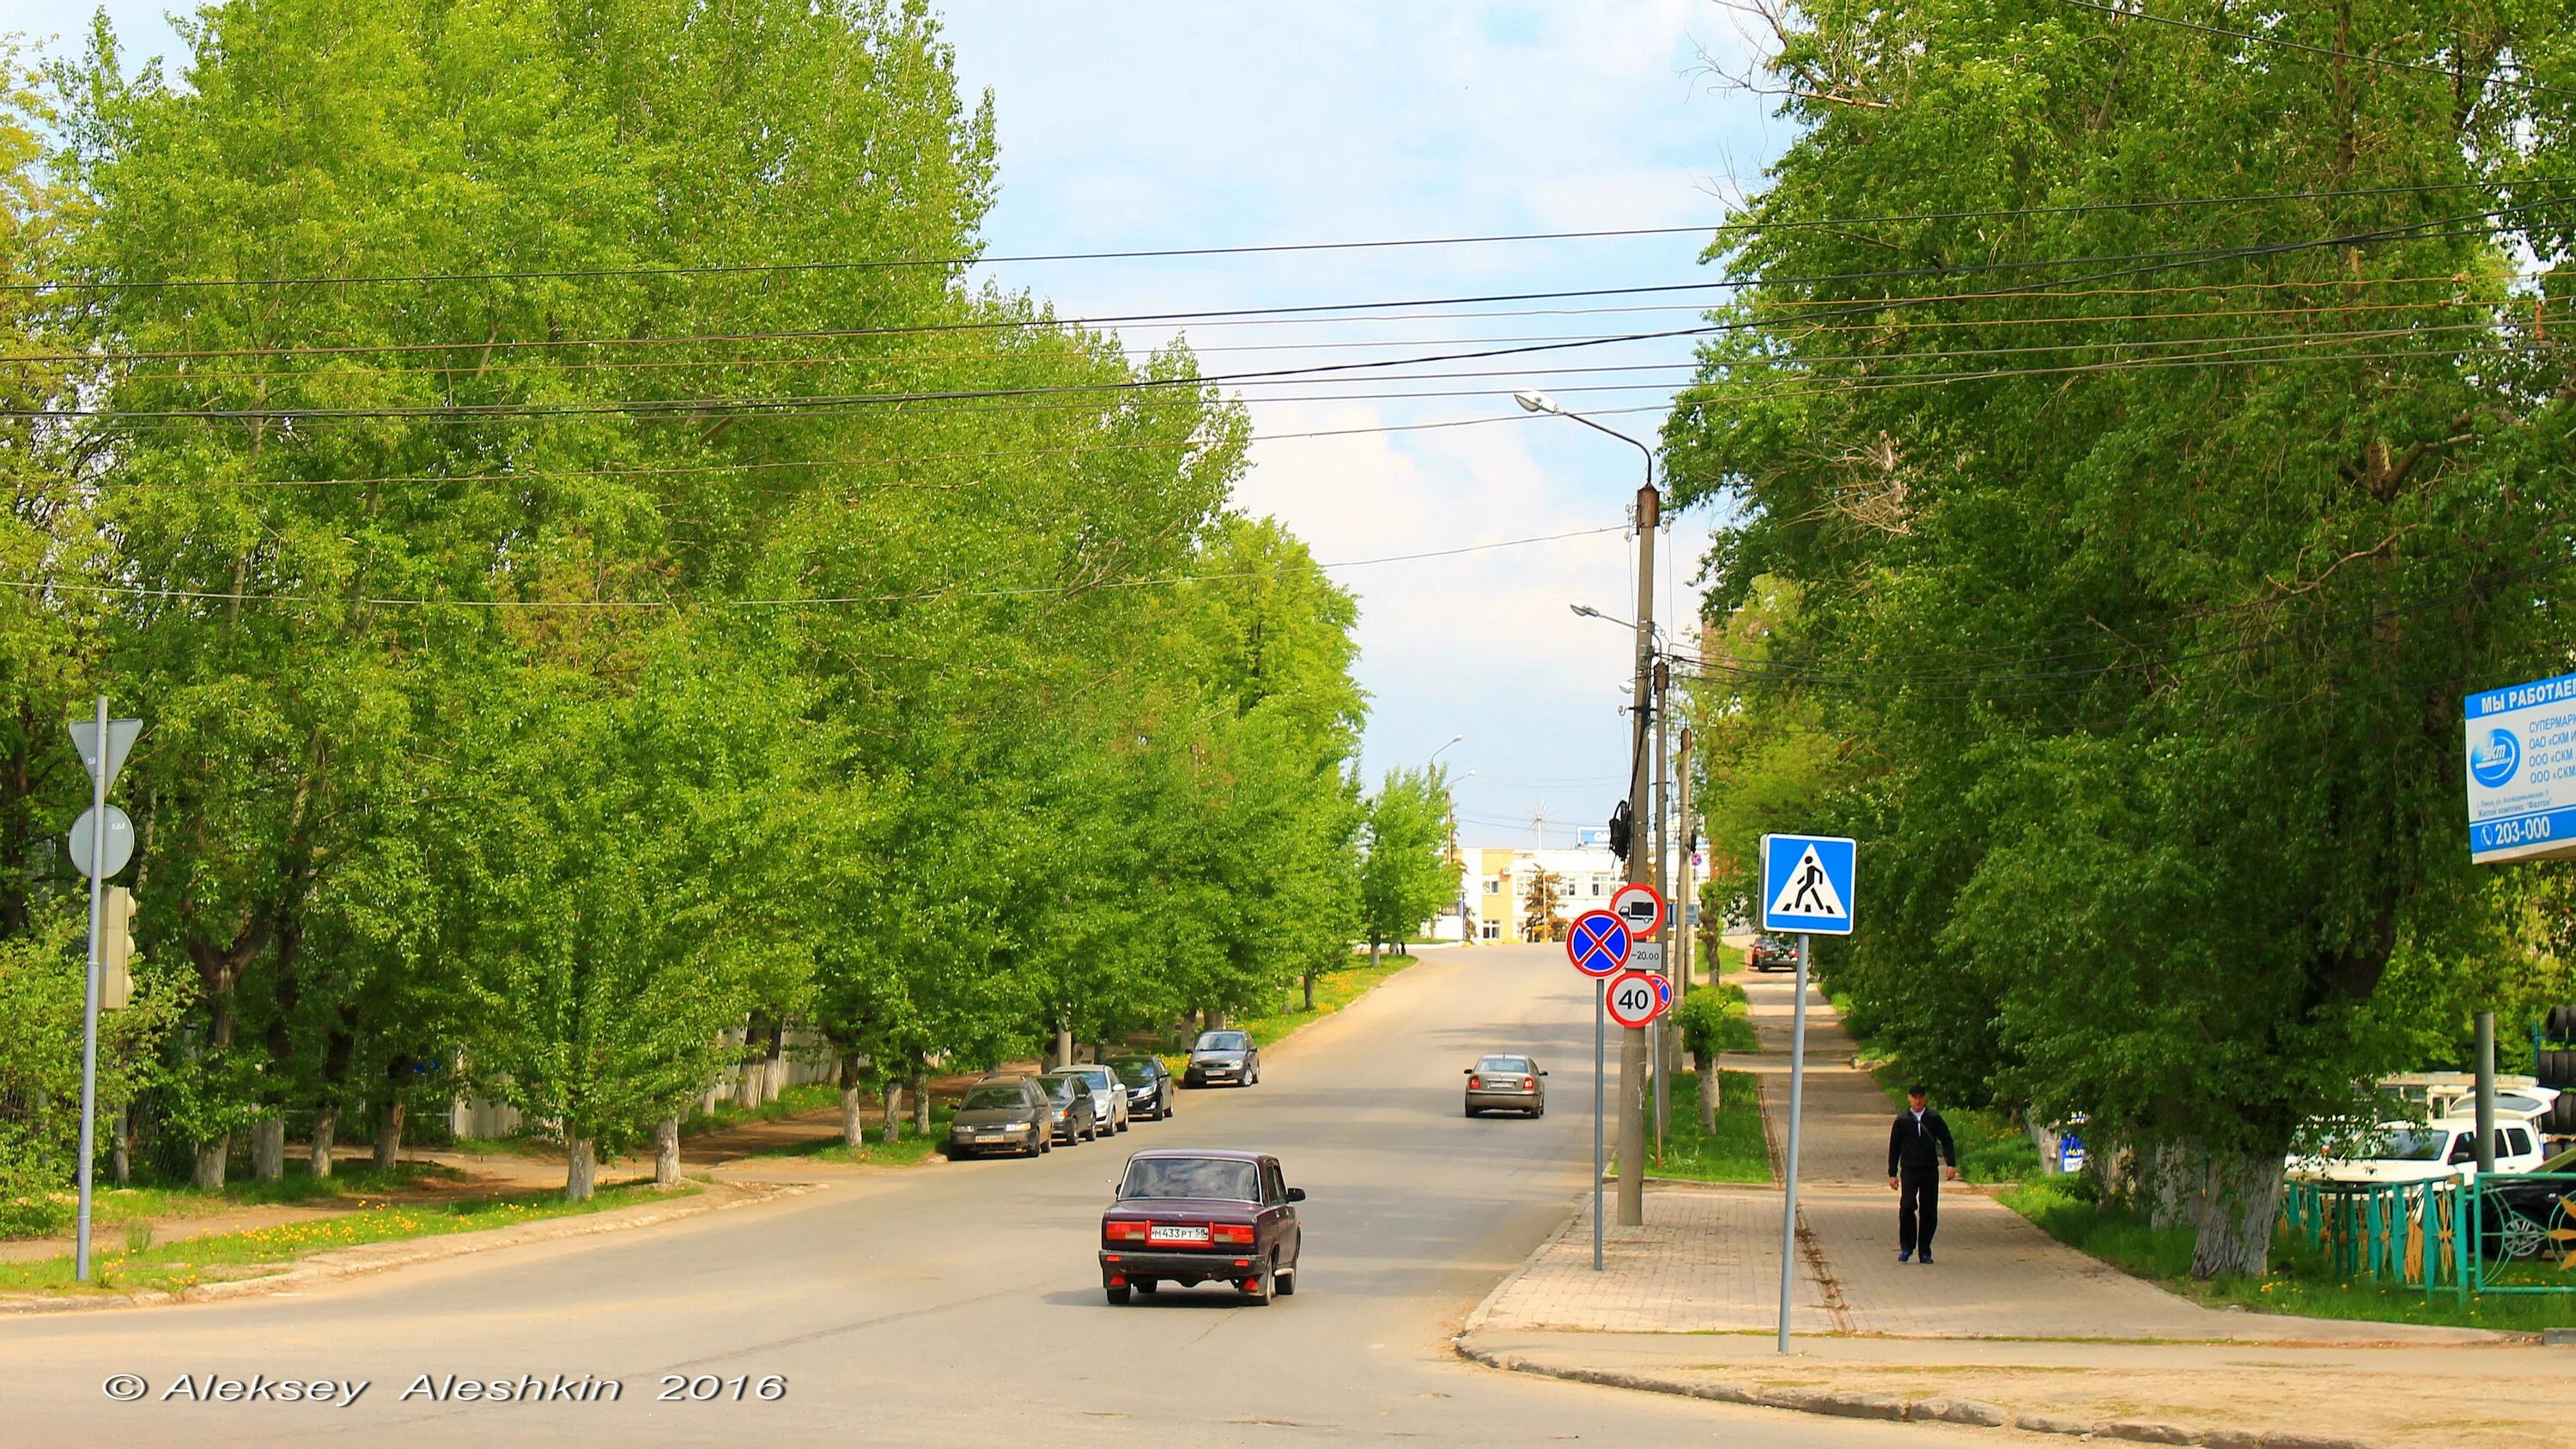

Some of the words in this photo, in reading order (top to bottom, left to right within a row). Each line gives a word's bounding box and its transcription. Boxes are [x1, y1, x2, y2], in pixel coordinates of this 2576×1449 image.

[2482, 694, 2505, 714] МЫ
[2529, 735, 2546, 750] ОАО
[2529, 753, 2549, 767] ООО
[2530, 770, 2550, 783] ООО
[2495, 816, 2550, 845] 203-000
[1618, 989, 1649, 1010] 40
